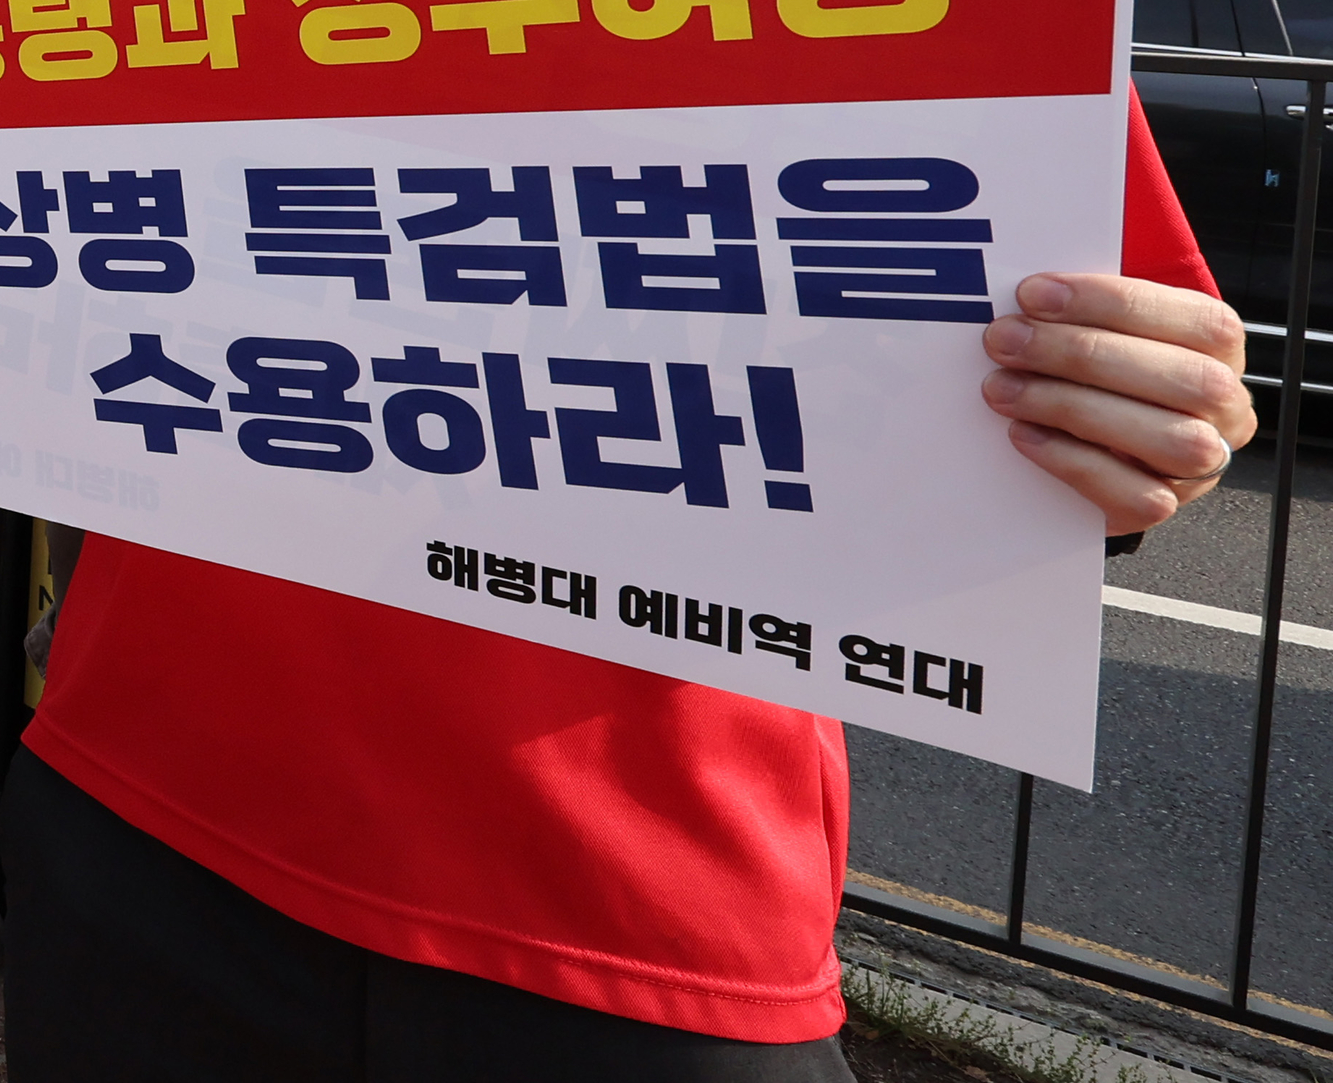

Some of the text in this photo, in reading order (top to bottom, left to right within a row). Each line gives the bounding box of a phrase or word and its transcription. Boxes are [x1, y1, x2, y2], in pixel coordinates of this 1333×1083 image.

[243, 155, 994, 325] 특검법을
[89, 332, 813, 514] 수용하라!
[424, 539, 985, 715] 해병대 예비역 연대
